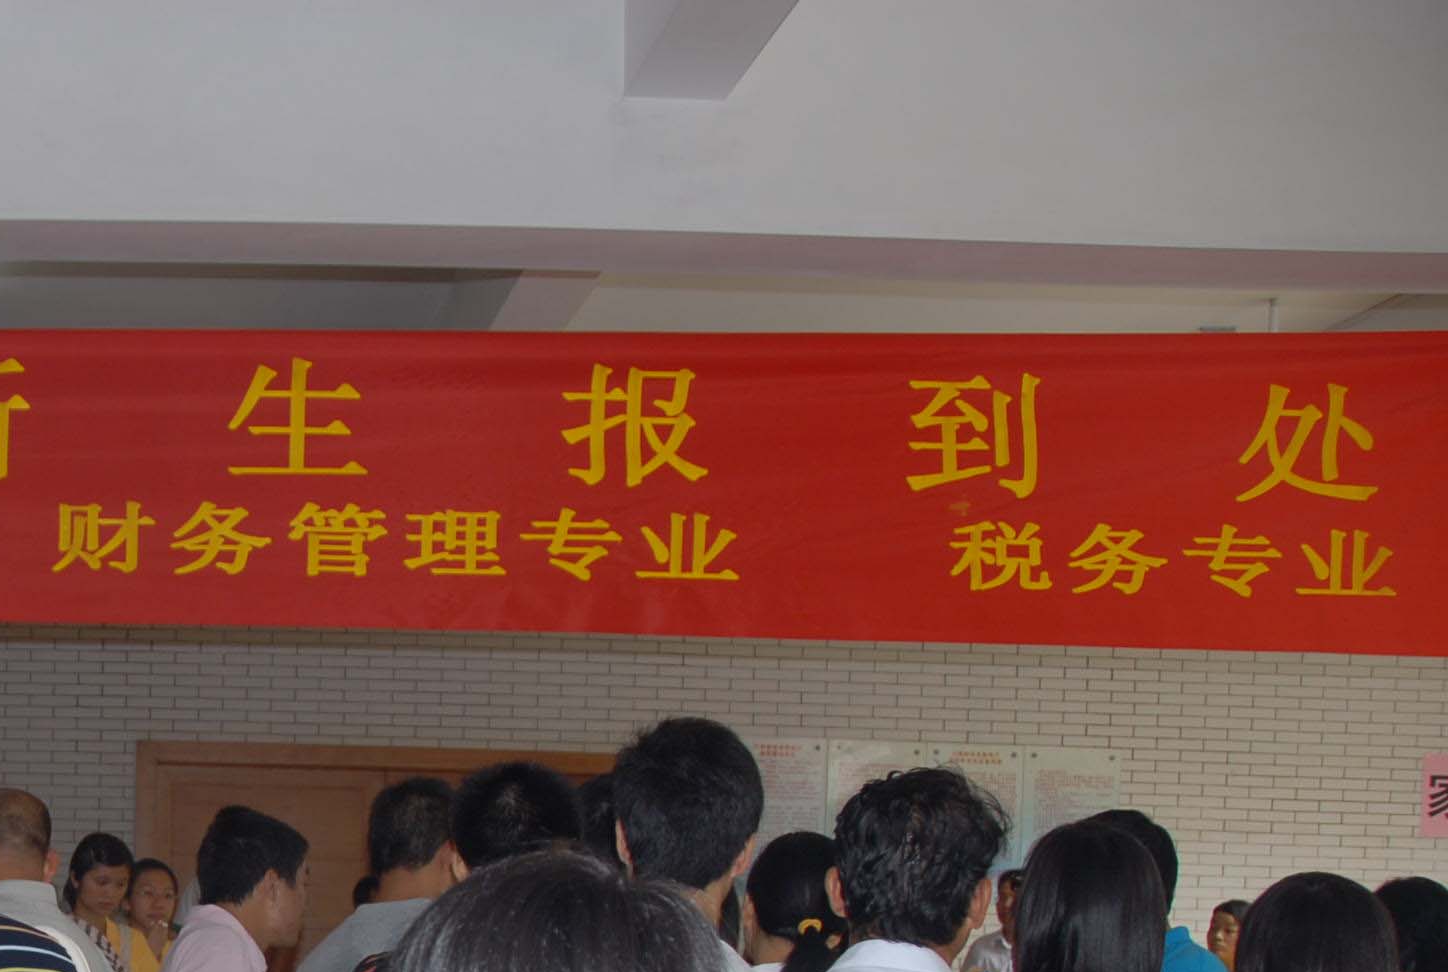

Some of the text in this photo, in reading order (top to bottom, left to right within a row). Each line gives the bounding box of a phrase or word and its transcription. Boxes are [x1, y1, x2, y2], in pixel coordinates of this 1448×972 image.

[52, 501, 739, 581] 财务管理专业
[951, 521, 1395, 597] 税务专业
